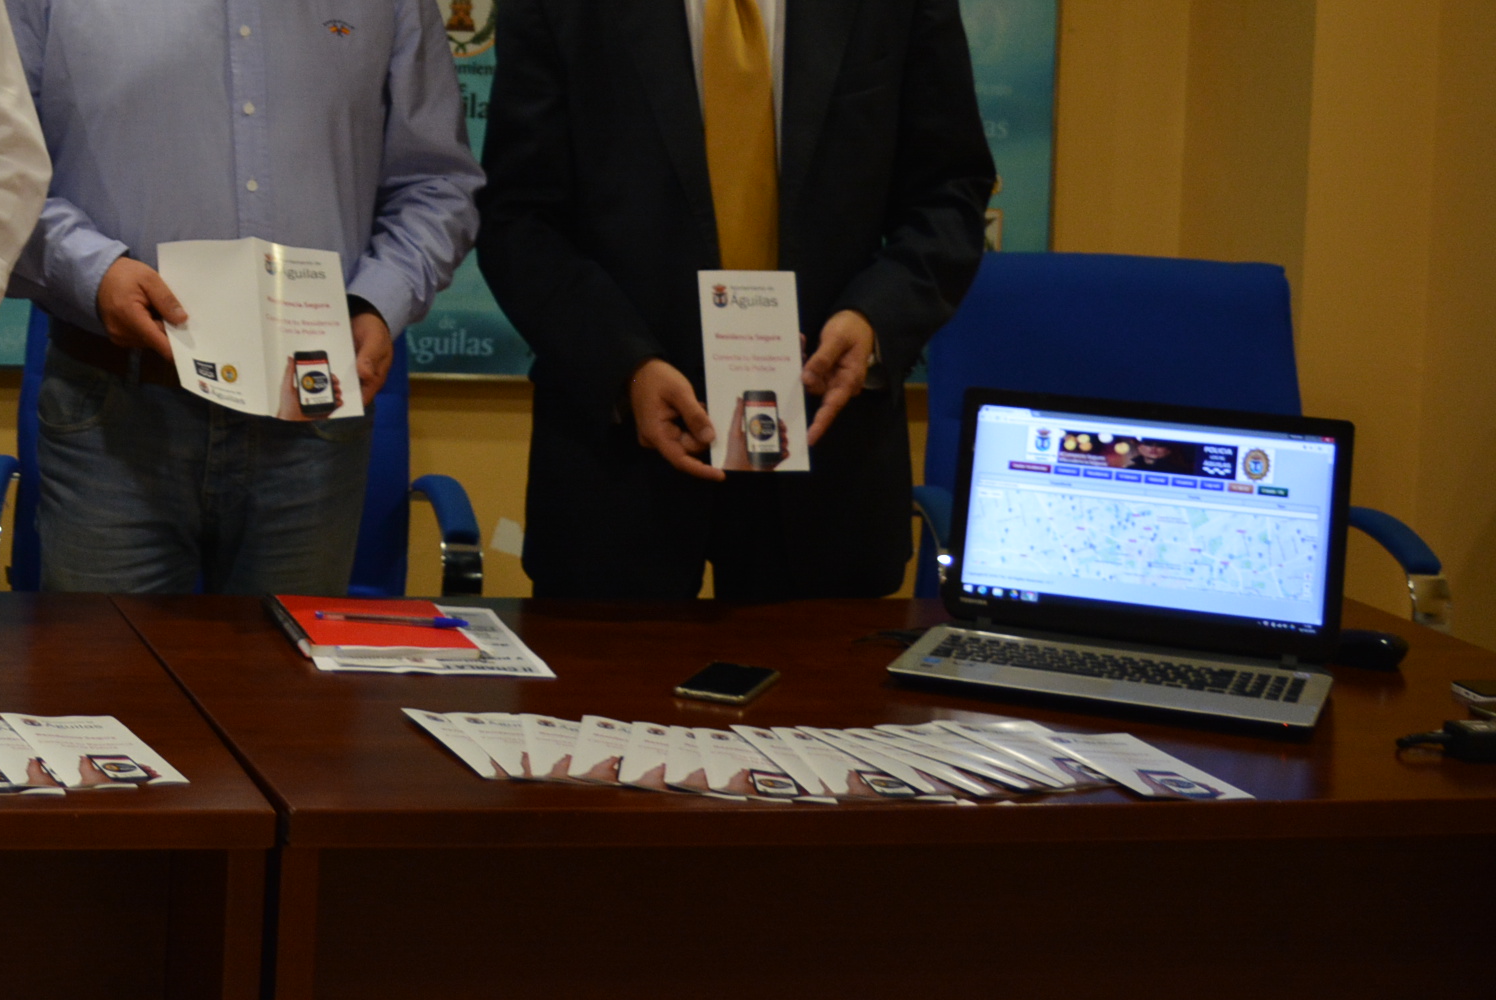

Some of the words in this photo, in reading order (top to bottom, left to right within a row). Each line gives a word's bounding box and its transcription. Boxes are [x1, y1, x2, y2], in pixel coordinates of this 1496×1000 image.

[284, 269, 327, 281] guilas
[730, 290, 779, 310] Águilas
[438, 313, 457, 330] de
